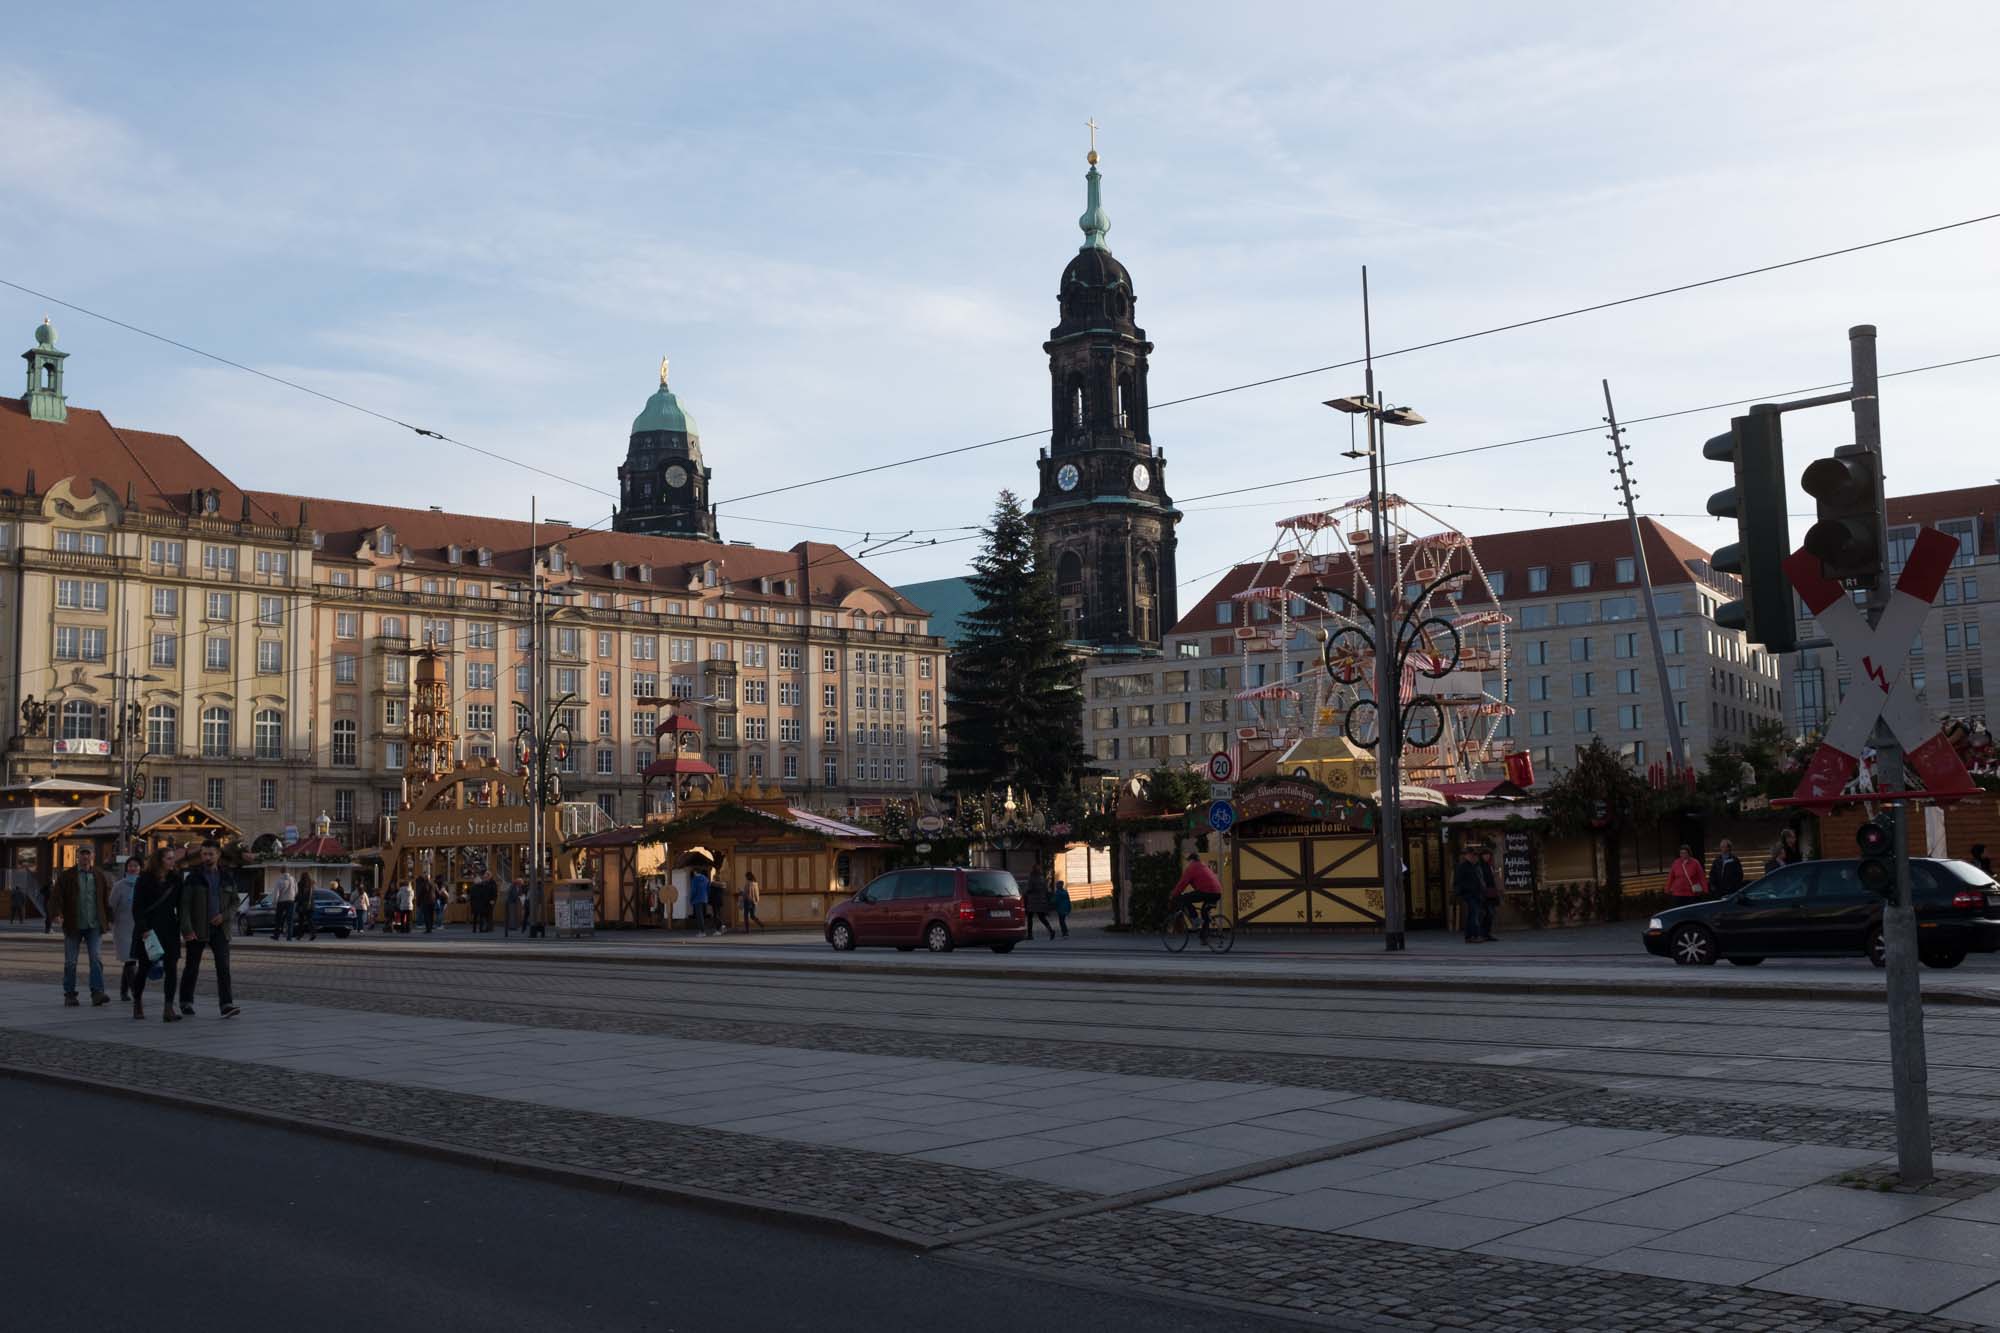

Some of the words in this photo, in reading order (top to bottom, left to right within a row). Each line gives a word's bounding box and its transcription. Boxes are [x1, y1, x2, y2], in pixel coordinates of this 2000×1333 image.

[1215, 760, 1228, 775] 20
[408, 820, 461, 837] Dresdner
[467, 817, 543, 835] Striezelma
